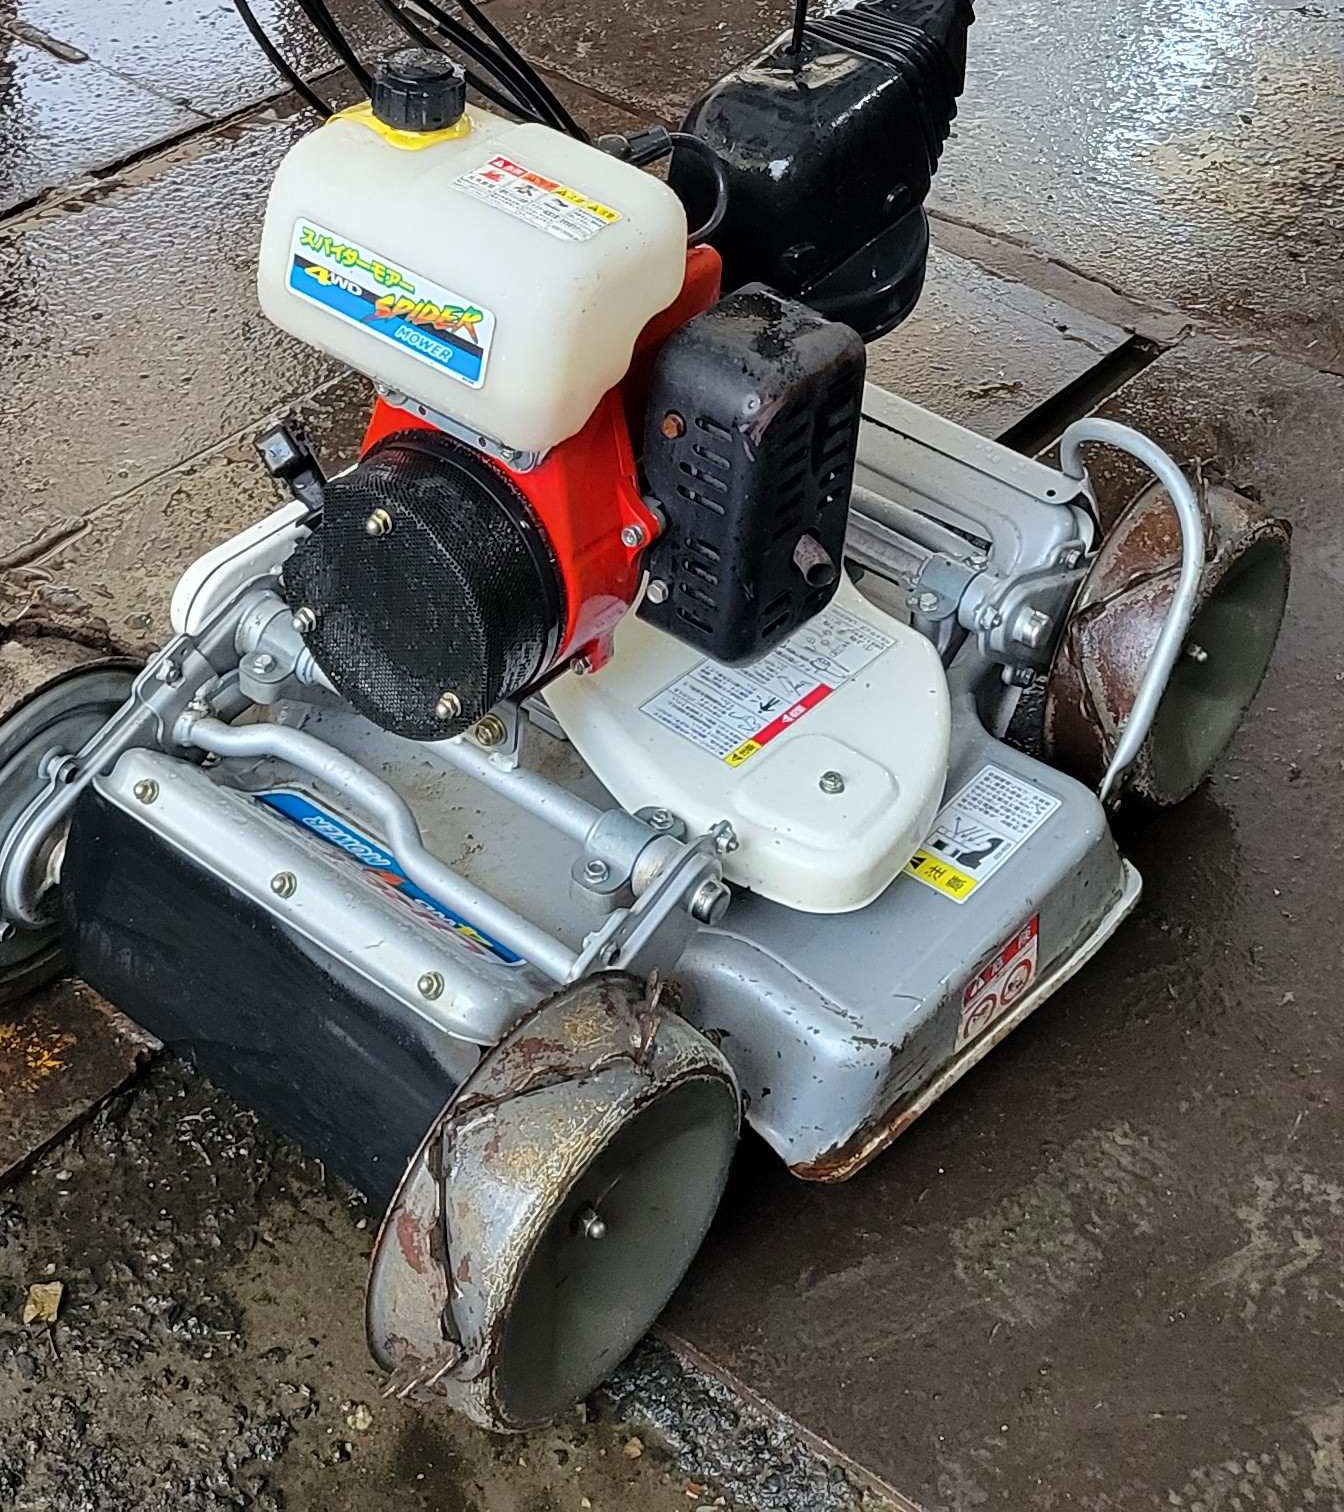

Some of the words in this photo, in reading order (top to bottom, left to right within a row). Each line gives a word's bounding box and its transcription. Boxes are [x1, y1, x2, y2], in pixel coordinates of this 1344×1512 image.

[300, 226, 416, 294] スパイダーモアー
[305, 264, 363, 296] 4WD
[359, 293, 484, 345] SPIDER
[394, 325, 454, 363] MOWER
[302, 815, 392, 867] MOWER
[924, 864, 967, 892] 注意
